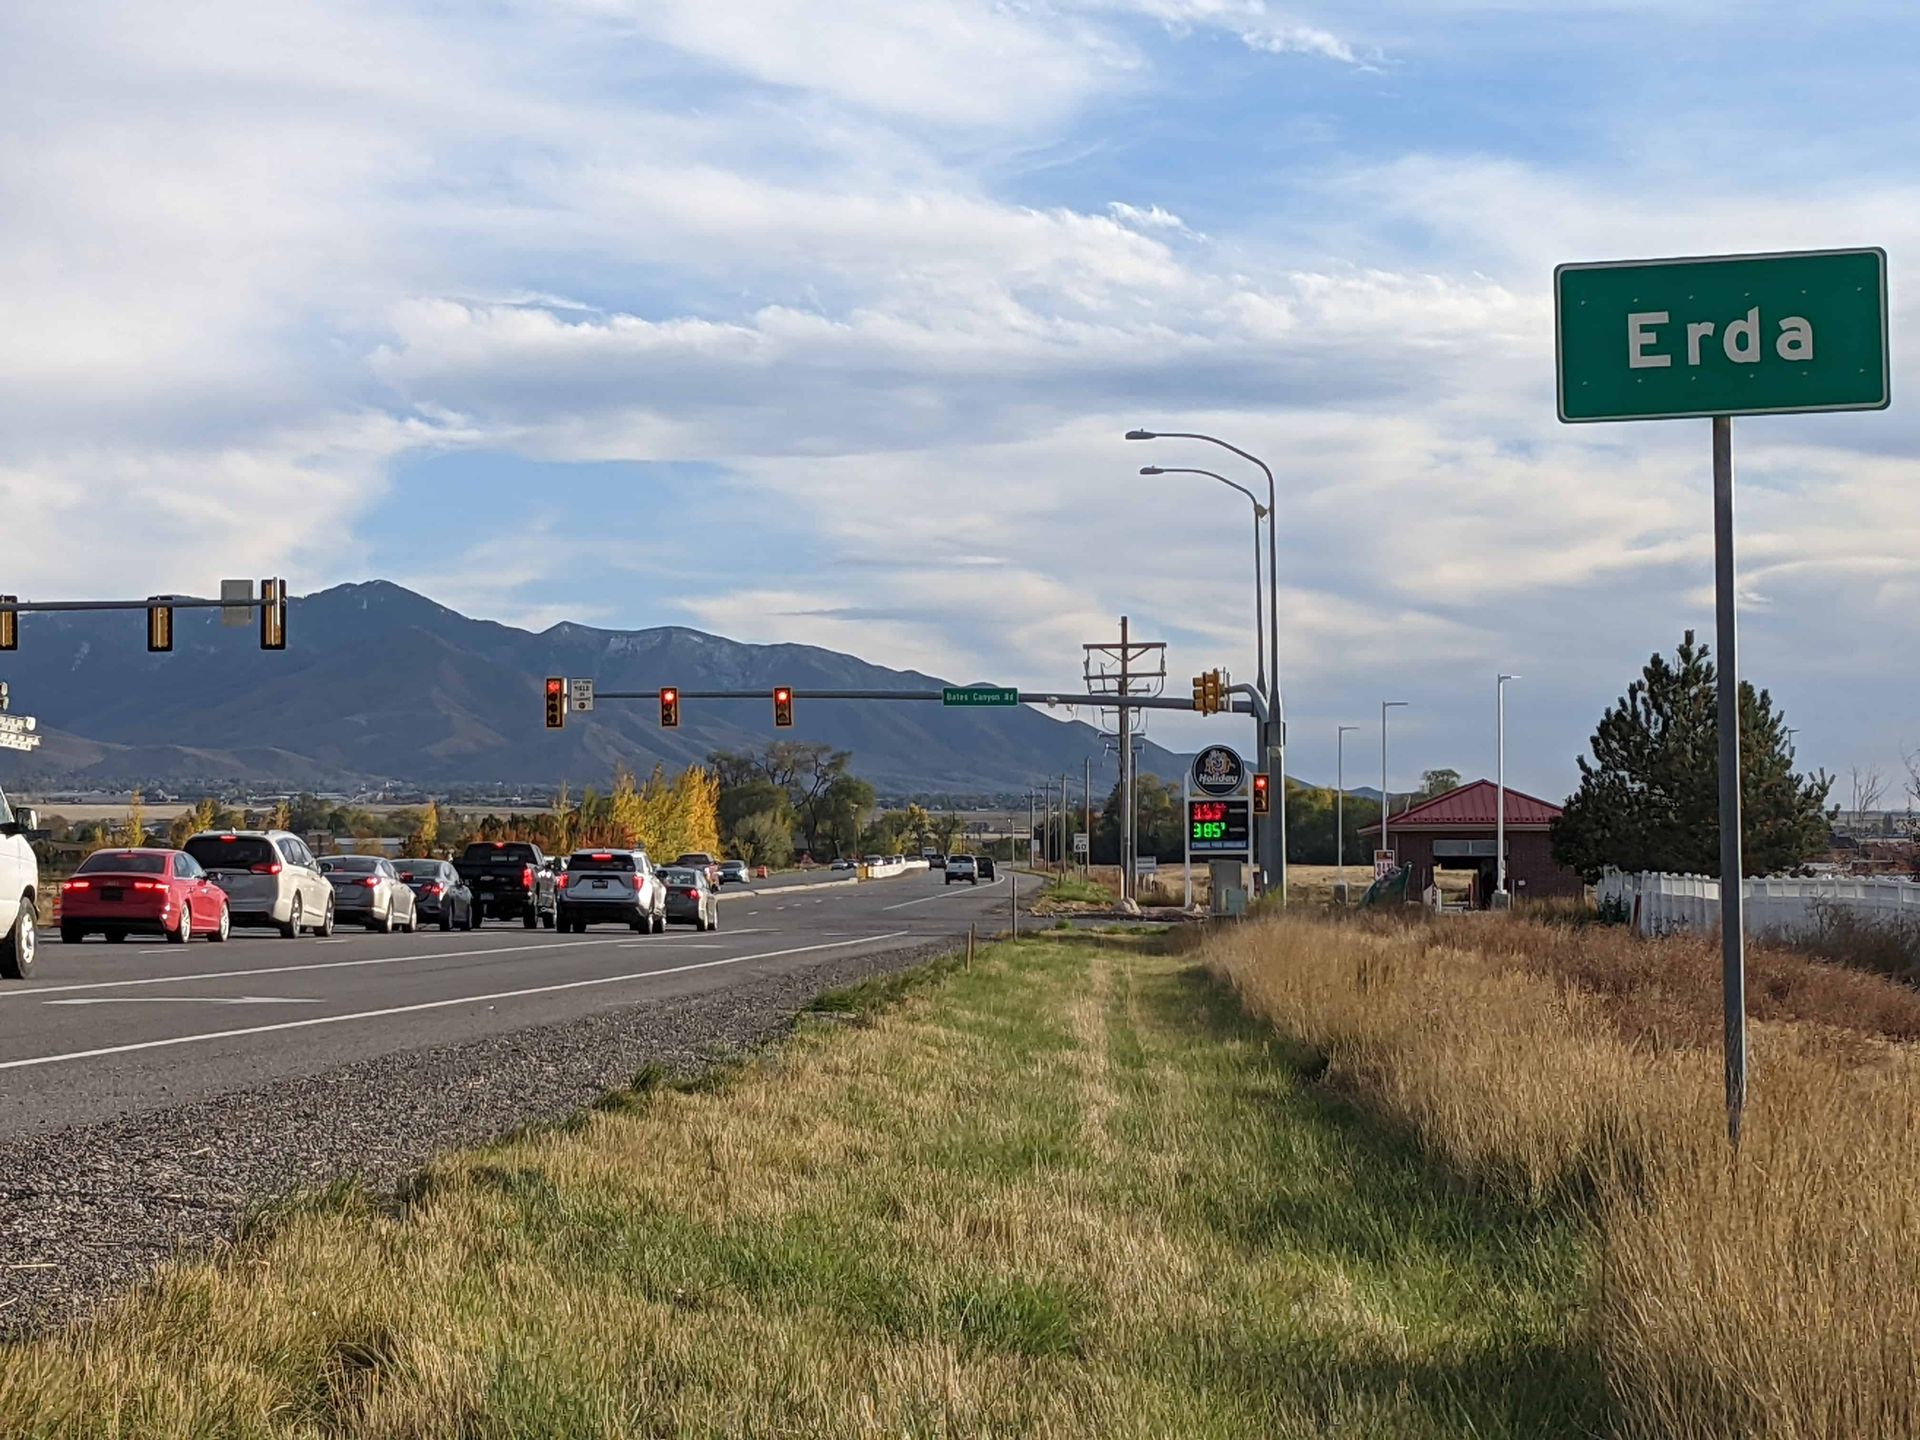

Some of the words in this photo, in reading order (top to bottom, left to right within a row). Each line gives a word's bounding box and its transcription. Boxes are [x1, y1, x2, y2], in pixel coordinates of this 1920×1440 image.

[1627, 306, 1813, 369] Erda
[946, 692, 968, 701] Bates
[973, 692, 1000, 703] Canyon
[1199, 773, 1238, 785] Holiday
[1075, 843, 1087, 851] 60
